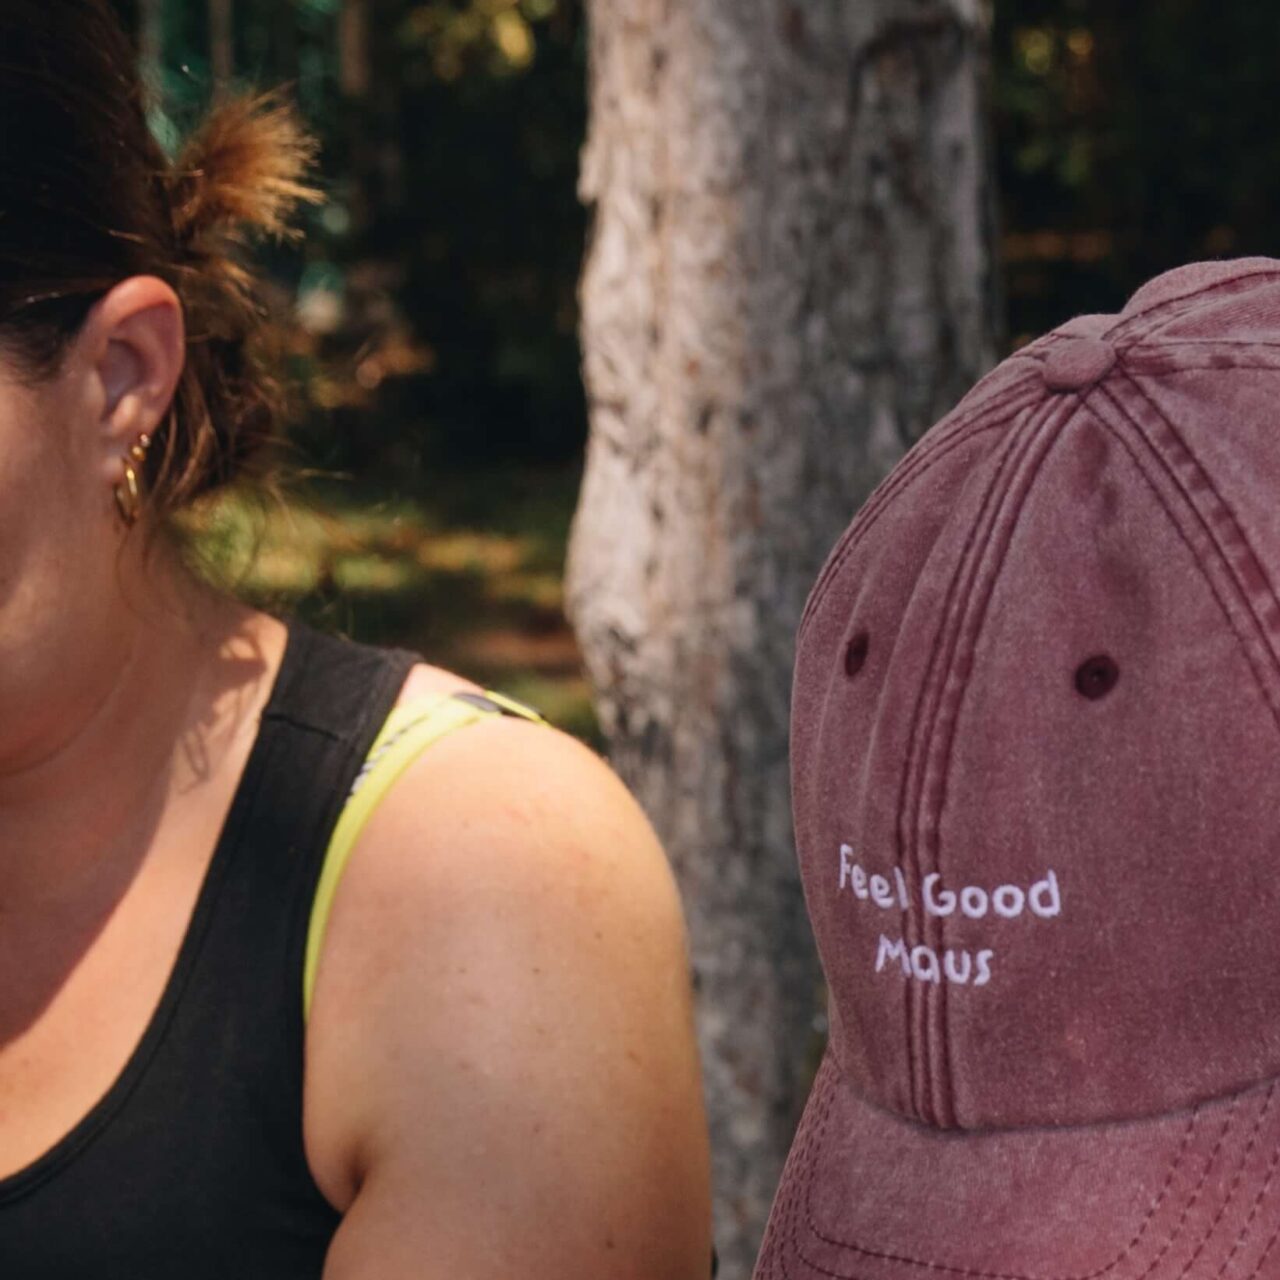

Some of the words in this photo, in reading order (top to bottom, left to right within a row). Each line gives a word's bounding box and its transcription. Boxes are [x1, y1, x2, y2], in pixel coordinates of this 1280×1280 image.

[839, 843, 909, 909] Feel
[922, 868, 1061, 918] Good
[875, 934, 993, 986] Maus
